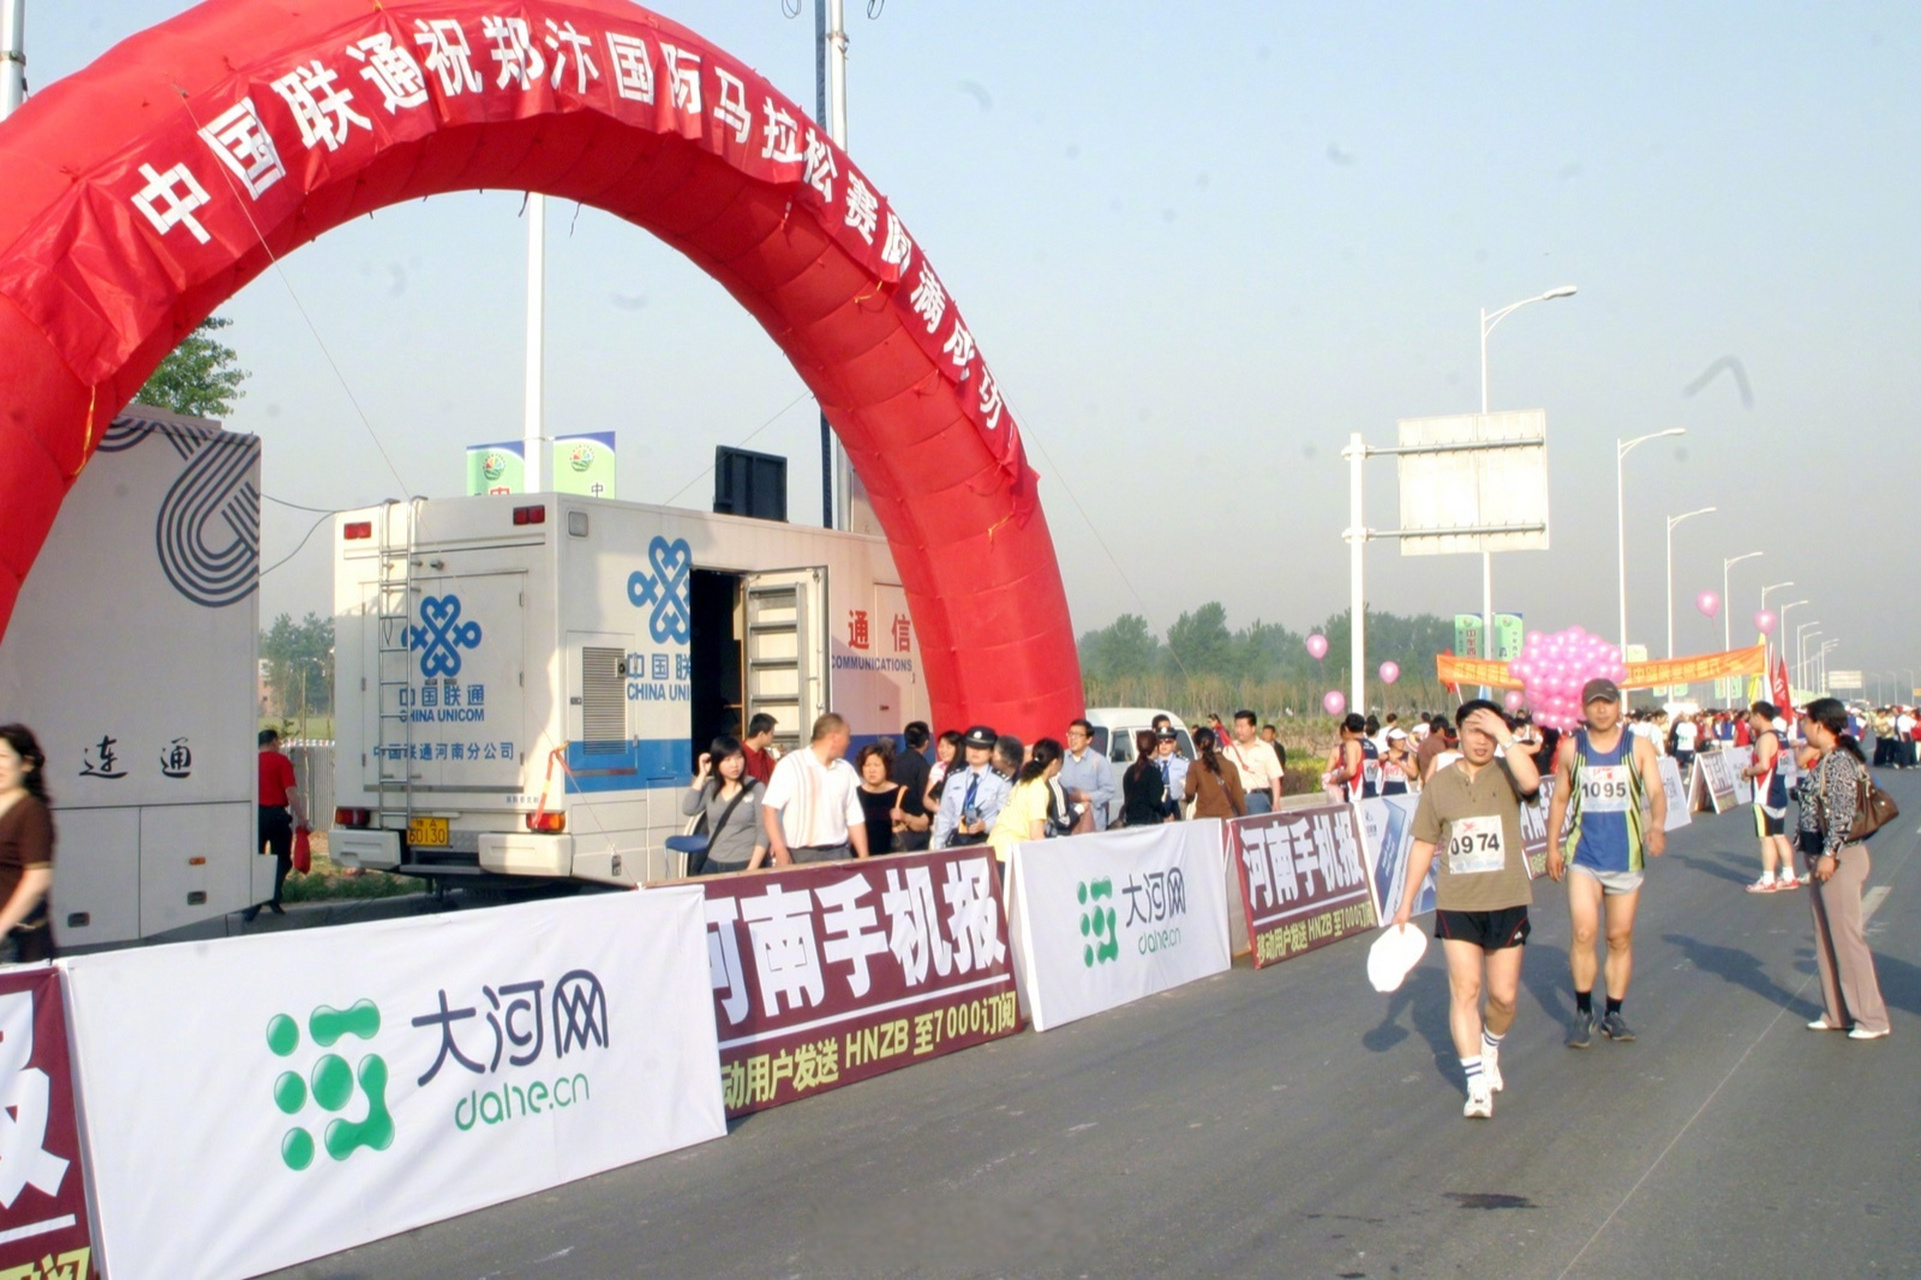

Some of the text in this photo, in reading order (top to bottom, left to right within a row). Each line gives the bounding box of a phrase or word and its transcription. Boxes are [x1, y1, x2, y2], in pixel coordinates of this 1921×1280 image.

[131, 16, 1002, 429] 中国联通祝郑汴国际马拉松赛圆满成功
[848, 609, 910, 652] 通信
[399, 683, 485, 707] 中国联通
[438, 707, 485, 722] UNICOM
[627, 682, 666, 701] CHINA
[1581, 781, 1627, 798] 1095
[1240, 810, 1365, 911] 河南手机报
[1450, 832, 1501, 856] 0974
[1121, 866, 1187, 929] 大河网
[1138, 927, 1182, 956] dahe.cn
[1256, 922, 1309, 965] 移动用户发送
[1308, 913, 1333, 942] HNZB
[412, 968, 610, 1087] 大河网
[845, 1018, 909, 1069] HNZB
[914, 990, 1017, 1056] 至7000订阅
[453, 1072, 590, 1132] dahe.cn
